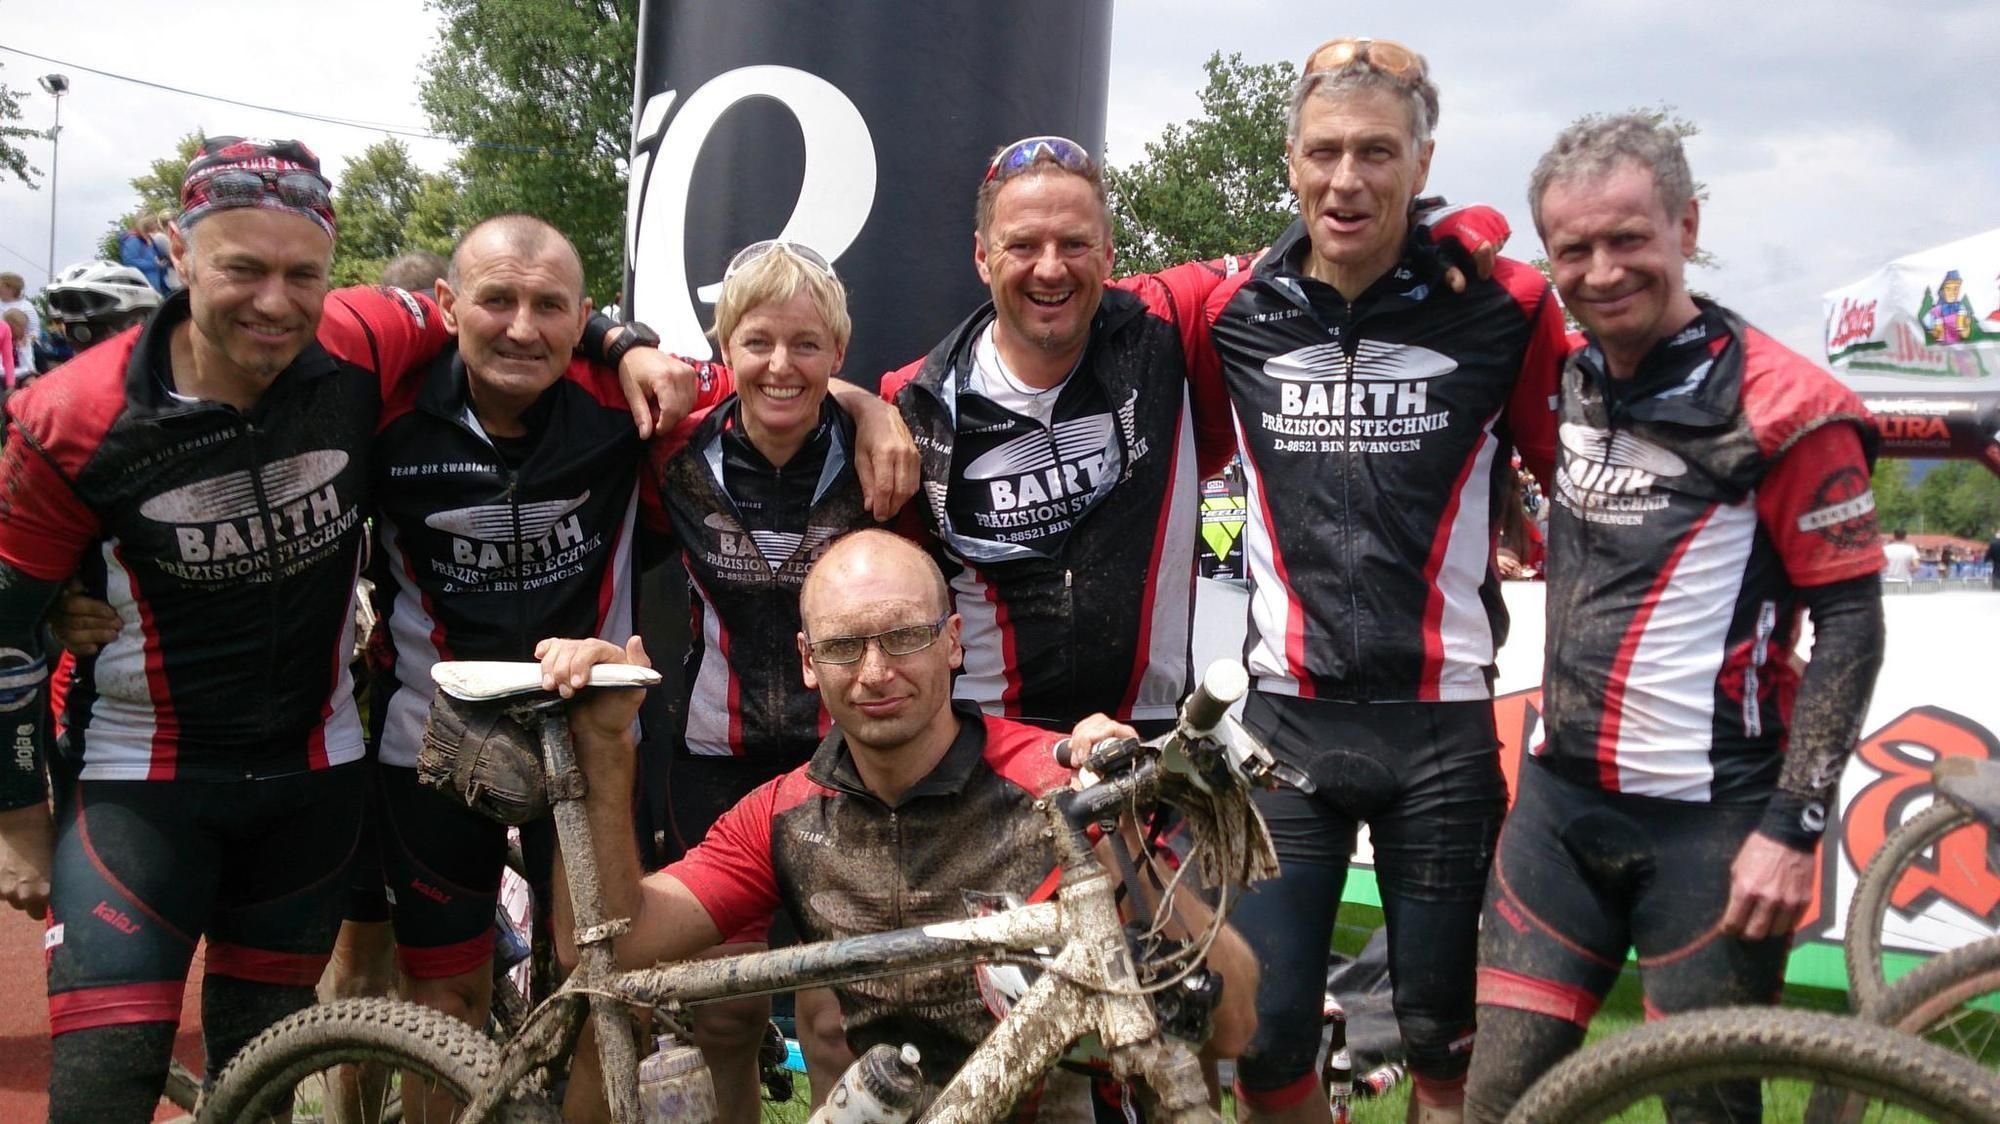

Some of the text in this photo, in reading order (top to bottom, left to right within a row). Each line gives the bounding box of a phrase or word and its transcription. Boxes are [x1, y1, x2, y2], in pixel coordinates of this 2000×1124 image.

[1281, 381, 1429, 416] BARTH
[1875, 416, 1952, 438] LTRA
[1273, 439, 1317, 453] D-88521
[391, 466, 419, 477] TEAM
[421, 464, 439, 475] SIX
[990, 451, 1105, 511] BART
[175, 482, 342, 563] BARTH
[453, 514, 584, 570] BARTH
[995, 527, 1046, 543] D-88521
[798, 830, 824, 844] TEAM
